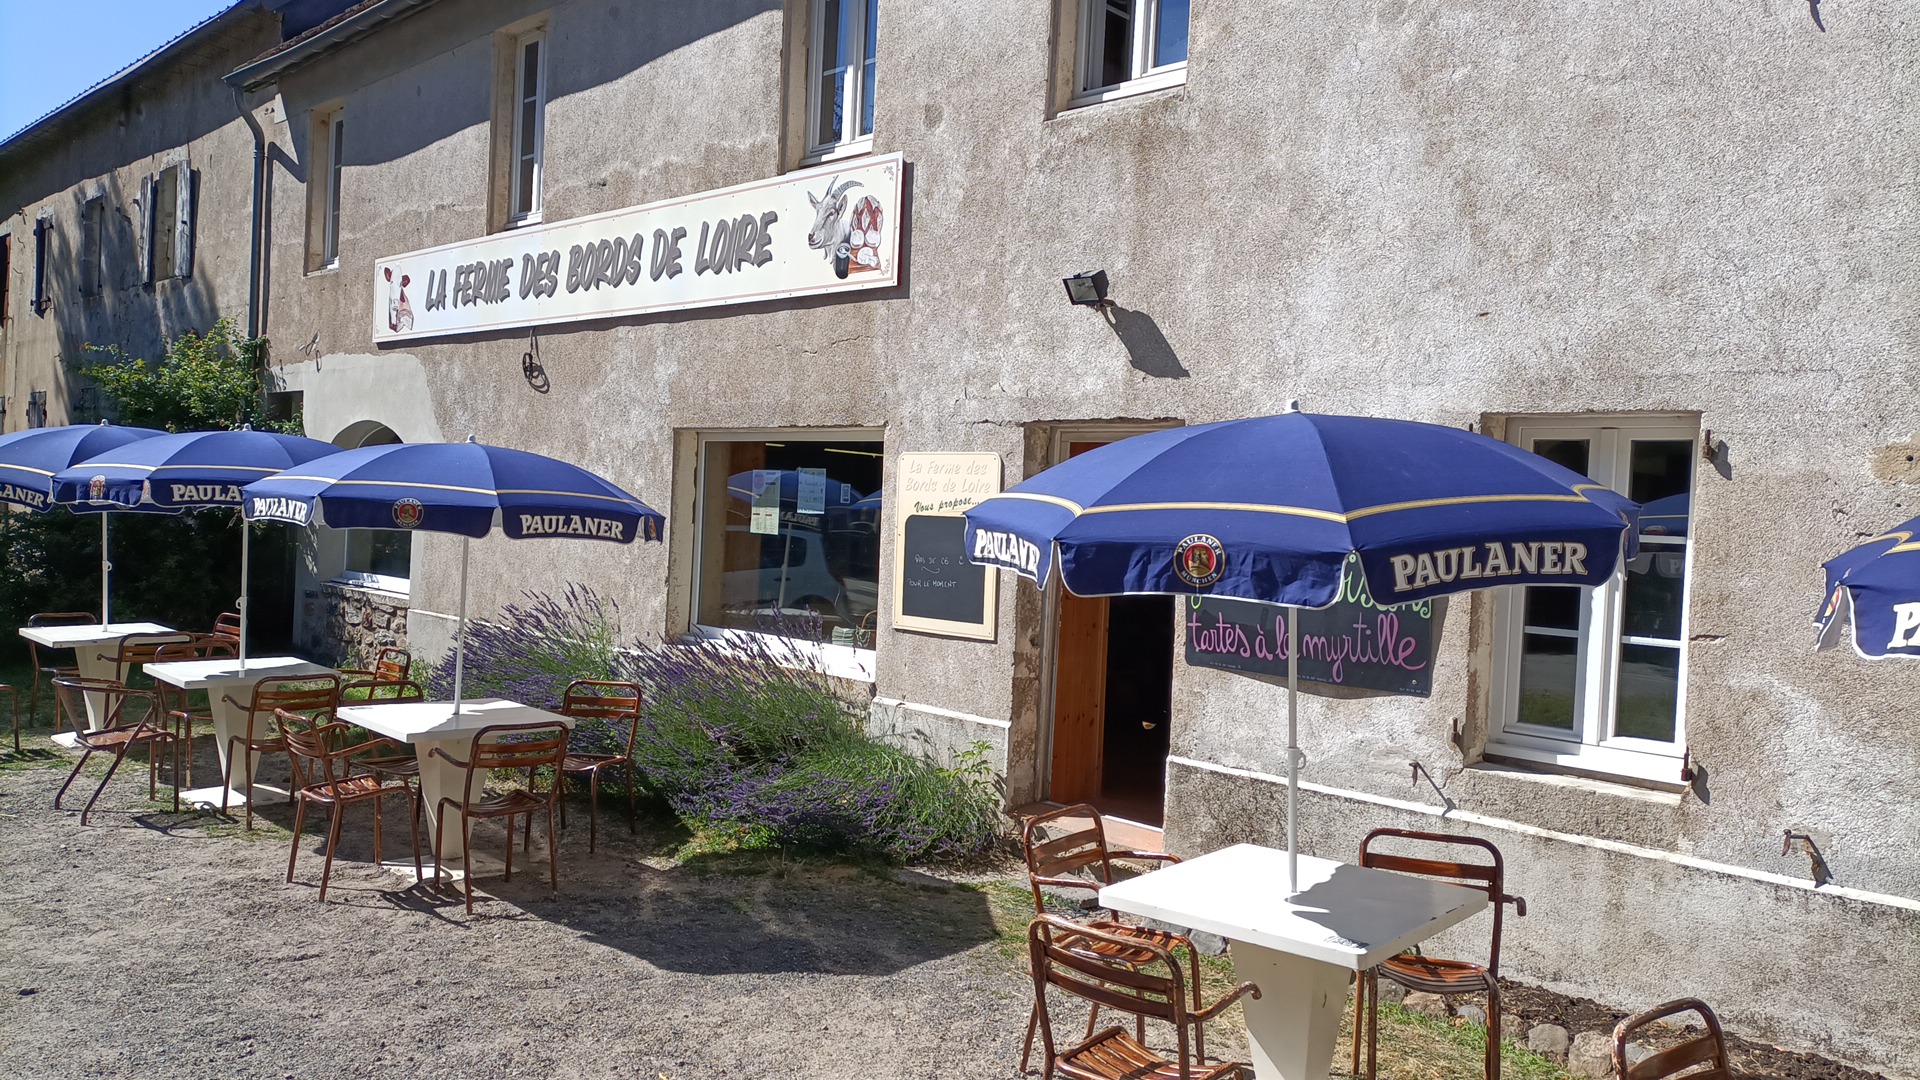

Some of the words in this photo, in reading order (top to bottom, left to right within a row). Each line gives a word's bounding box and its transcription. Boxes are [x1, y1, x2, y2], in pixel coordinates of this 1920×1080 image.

[425, 269, 447, 312] LA
[452, 258, 514, 309] FERME
[519, 250, 561, 300] DES
[566, 232, 644, 294] BORDS
[650, 226, 687, 282] DE
[695, 211, 778, 277] LOIRE
[909, 460, 922, 475] La
[927, 460, 962, 475] Ferme
[966, 460, 988, 476] des
[170, 484, 242, 502] PAULA
[905, 477, 938, 493] Bords
[942, 478, 957, 493] de
[961, 478, 991, 494] Loire
[914, 501, 934, 513] Vous
[520, 514, 624, 540] PAULANER
[1178, 536, 1221, 555] PAULANER
[1390, 542, 1589, 592] PAULANER
[1187, 611, 1251, 658] tartes
[1255, 624, 1274, 661] à
[1302, 611, 1427, 683] myrtille
